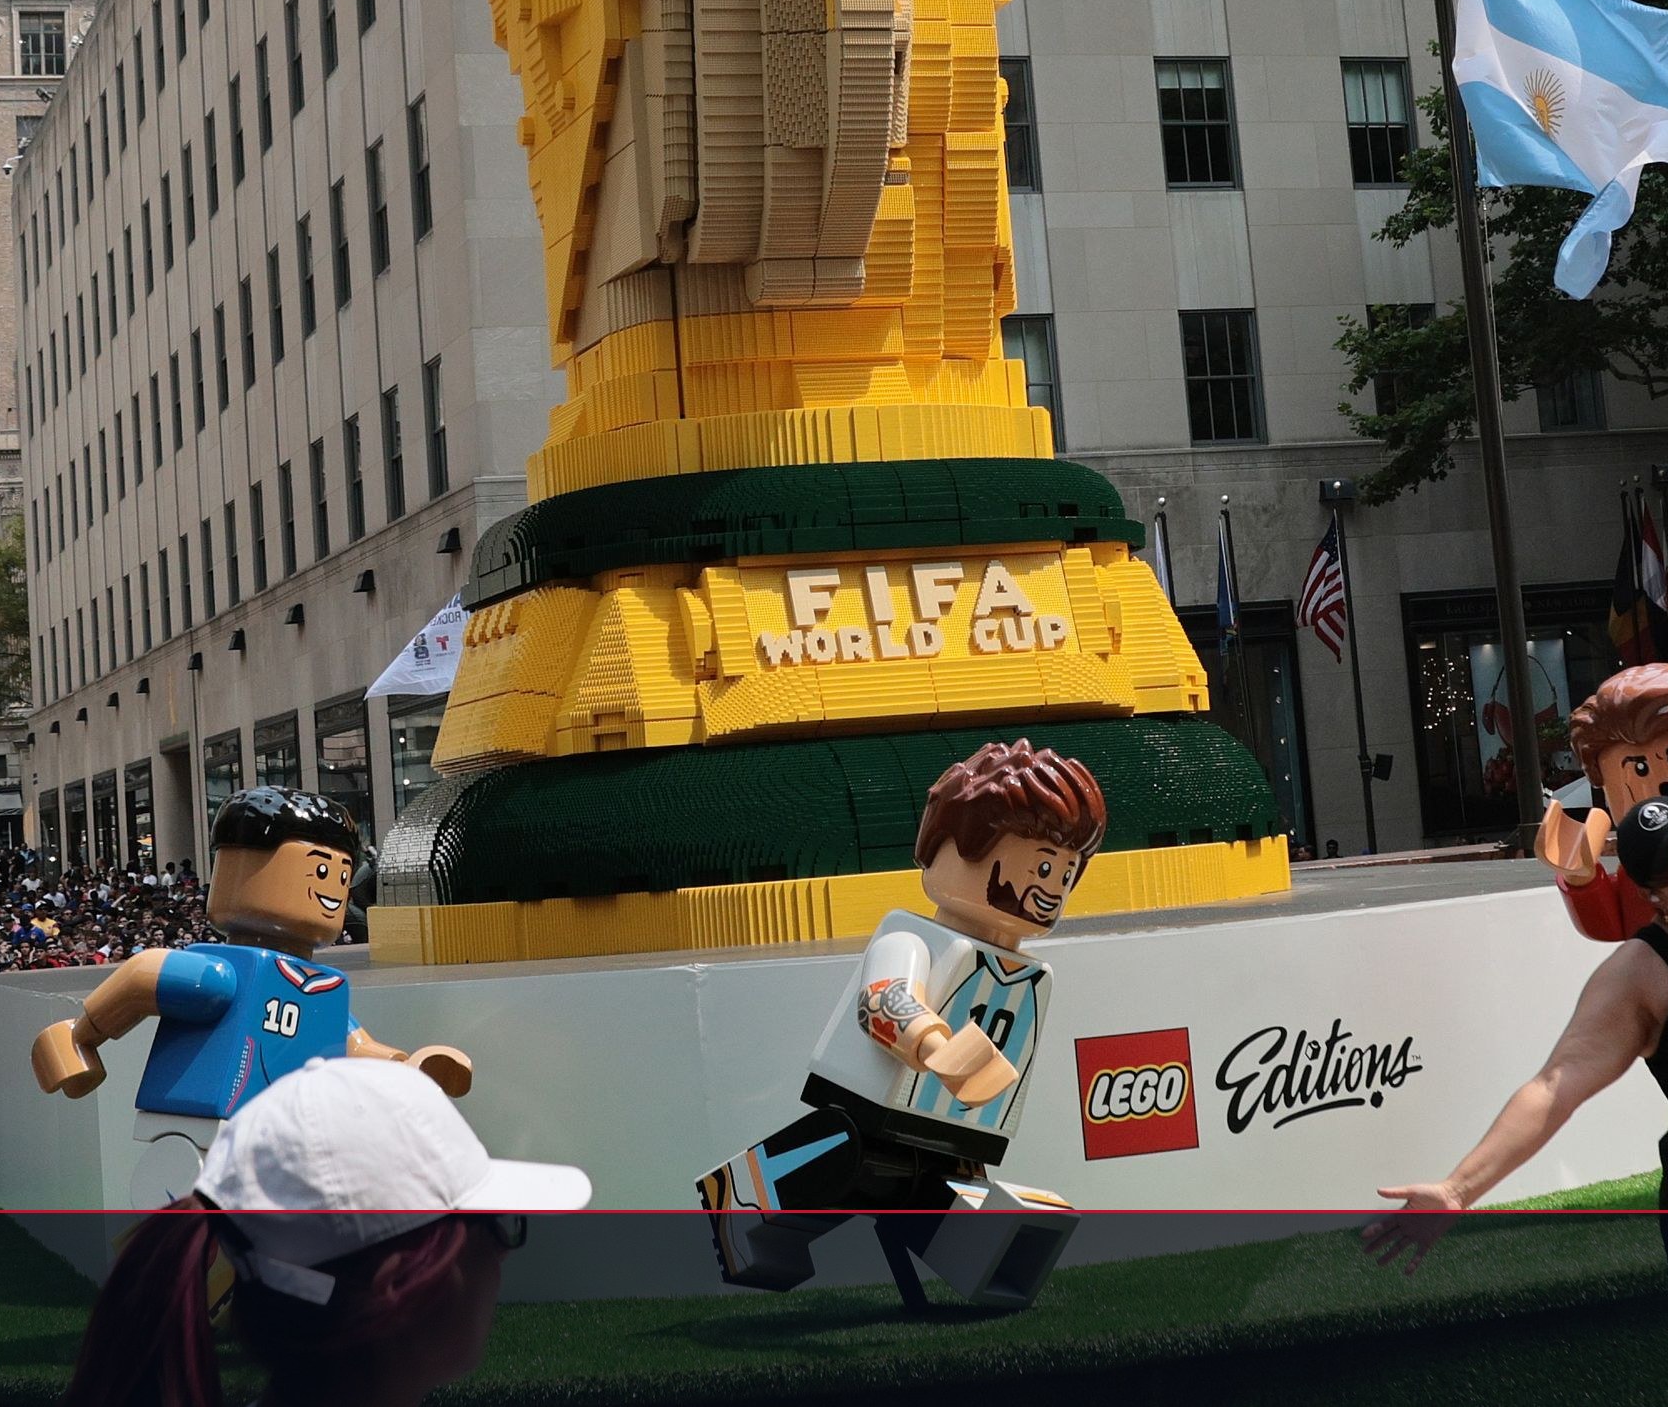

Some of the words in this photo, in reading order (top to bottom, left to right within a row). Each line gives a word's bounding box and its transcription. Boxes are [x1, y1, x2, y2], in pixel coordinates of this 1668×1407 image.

[787, 560, 1035, 627] FIFA
[758, 621, 944, 667] WORLD
[972, 615, 1068, 654] CUP
[262, 997, 300, 1038] 10
[1087, 1063, 1186, 1122] LEGO
[1216, 1018, 1423, 1134] Editions
